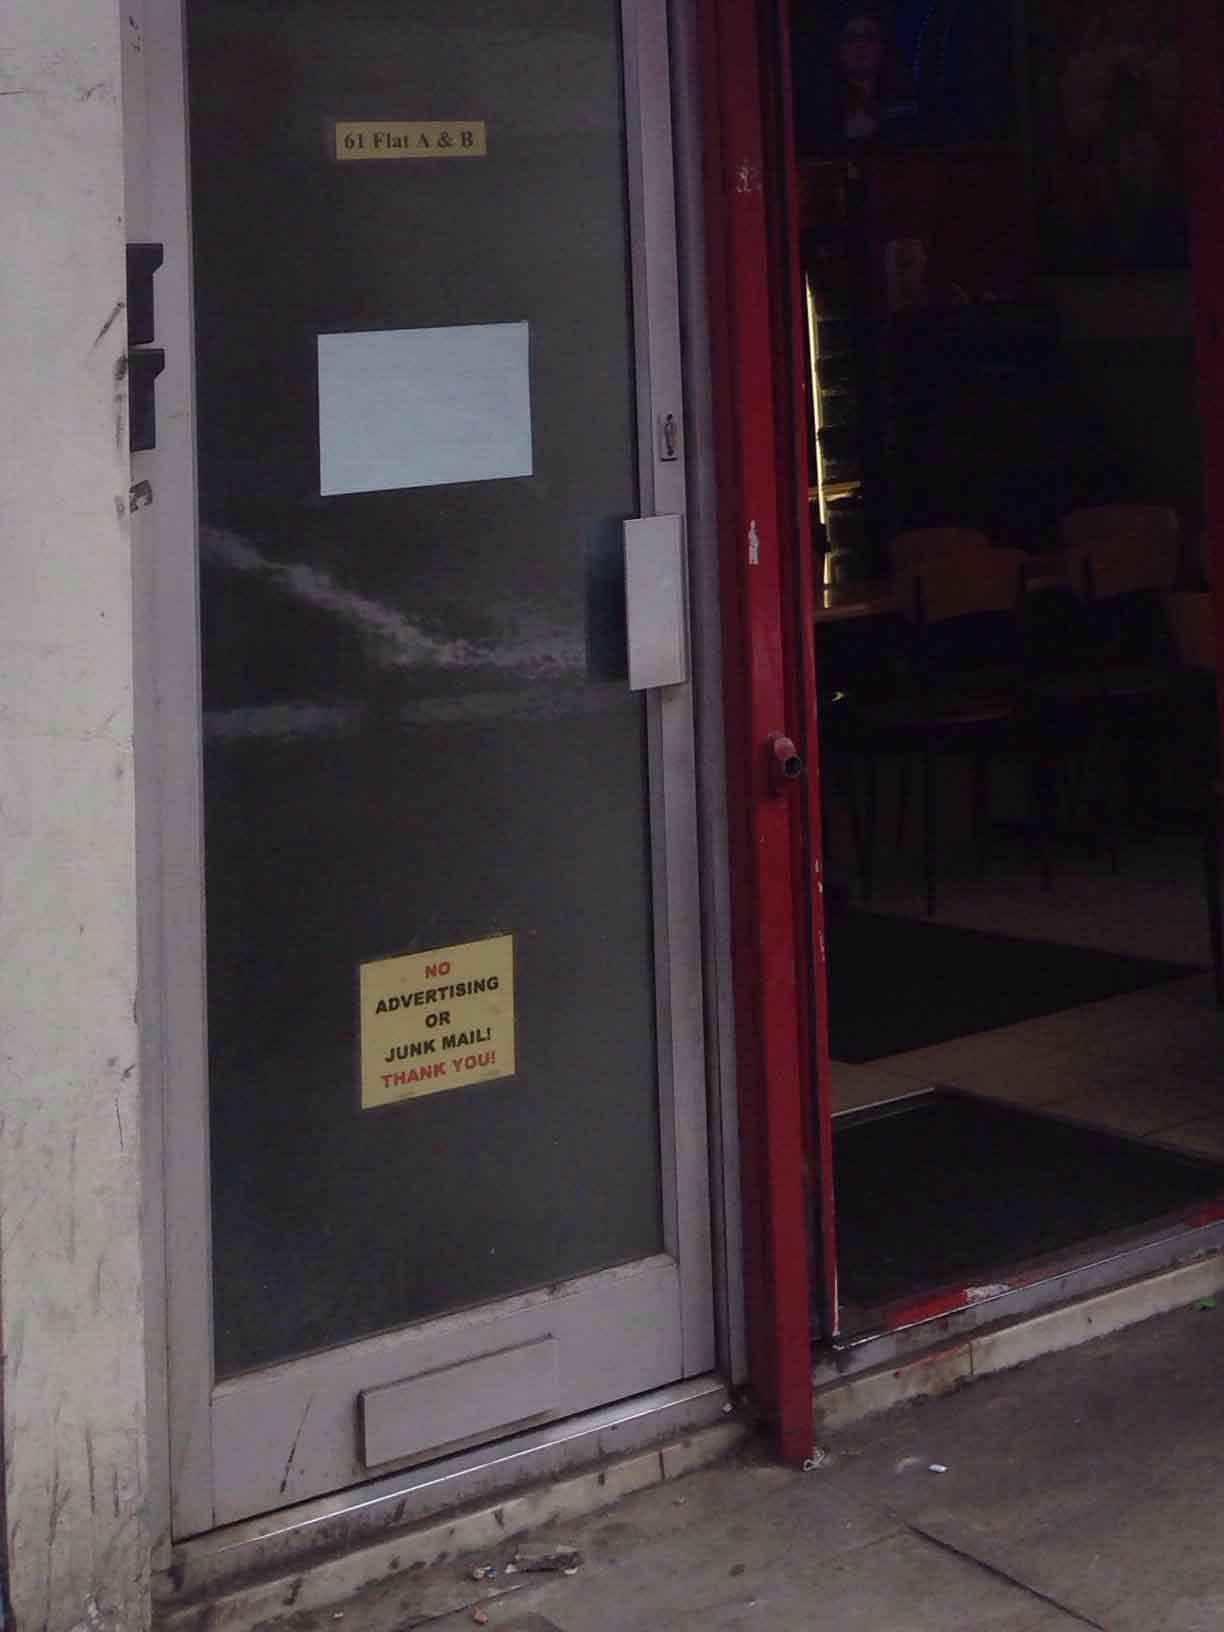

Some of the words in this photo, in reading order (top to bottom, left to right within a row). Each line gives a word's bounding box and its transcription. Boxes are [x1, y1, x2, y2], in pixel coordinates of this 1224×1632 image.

[344, 132, 364, 150] 61
[373, 131, 409, 149] Flat
[416, 131, 431, 149] A
[437, 130, 455, 149] &
[461, 130, 474, 149] B
[425, 961, 451, 979] NO
[375, 976, 499, 1014] ADVERTISING
[425, 1011, 451, 1028] OR
[384, 1039, 436, 1063] JUNK
[442, 1027, 491, 1050] MAIL!
[382, 1062, 446, 1088] THANK
[453, 1051, 496, 1072] YOU!
